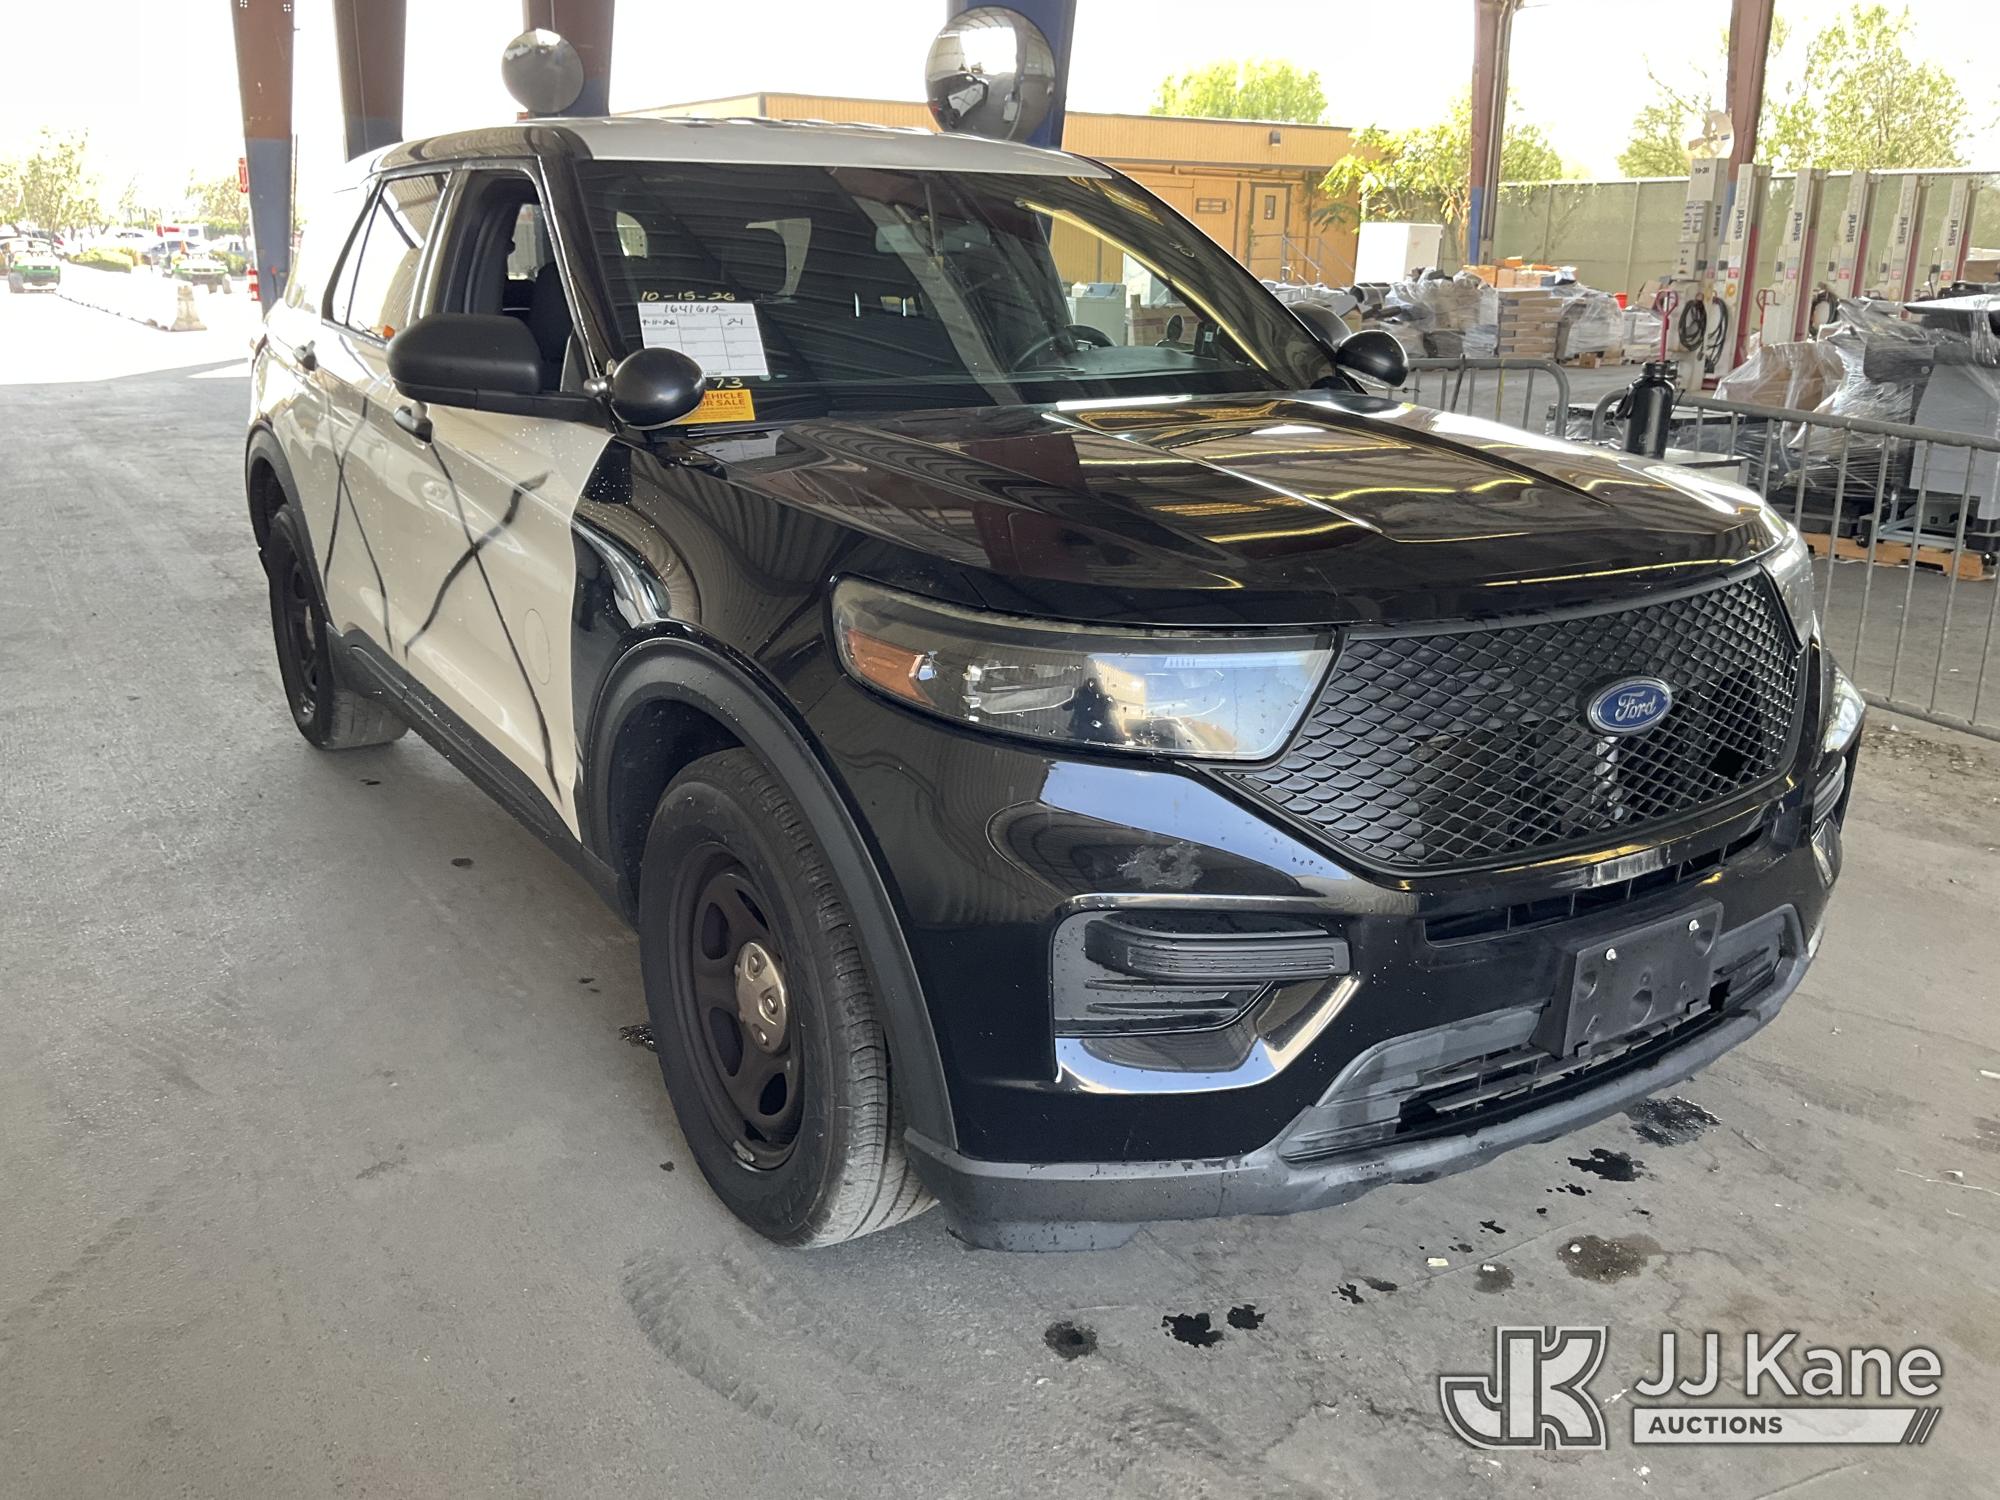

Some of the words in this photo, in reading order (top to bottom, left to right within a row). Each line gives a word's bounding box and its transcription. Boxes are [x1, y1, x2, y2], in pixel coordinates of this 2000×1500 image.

[1734, 209, 1745, 239] stertil
[1792, 212, 1803, 241] stertil
[1846, 214, 1857, 243] stertil
[1898, 216, 1909, 244] stertil
[1948, 219, 1959, 247] stertil
[704, 392, 744, 400] EHICLE
[716, 399, 745, 407] SALE
[1614, 690, 1657, 722] Ford
